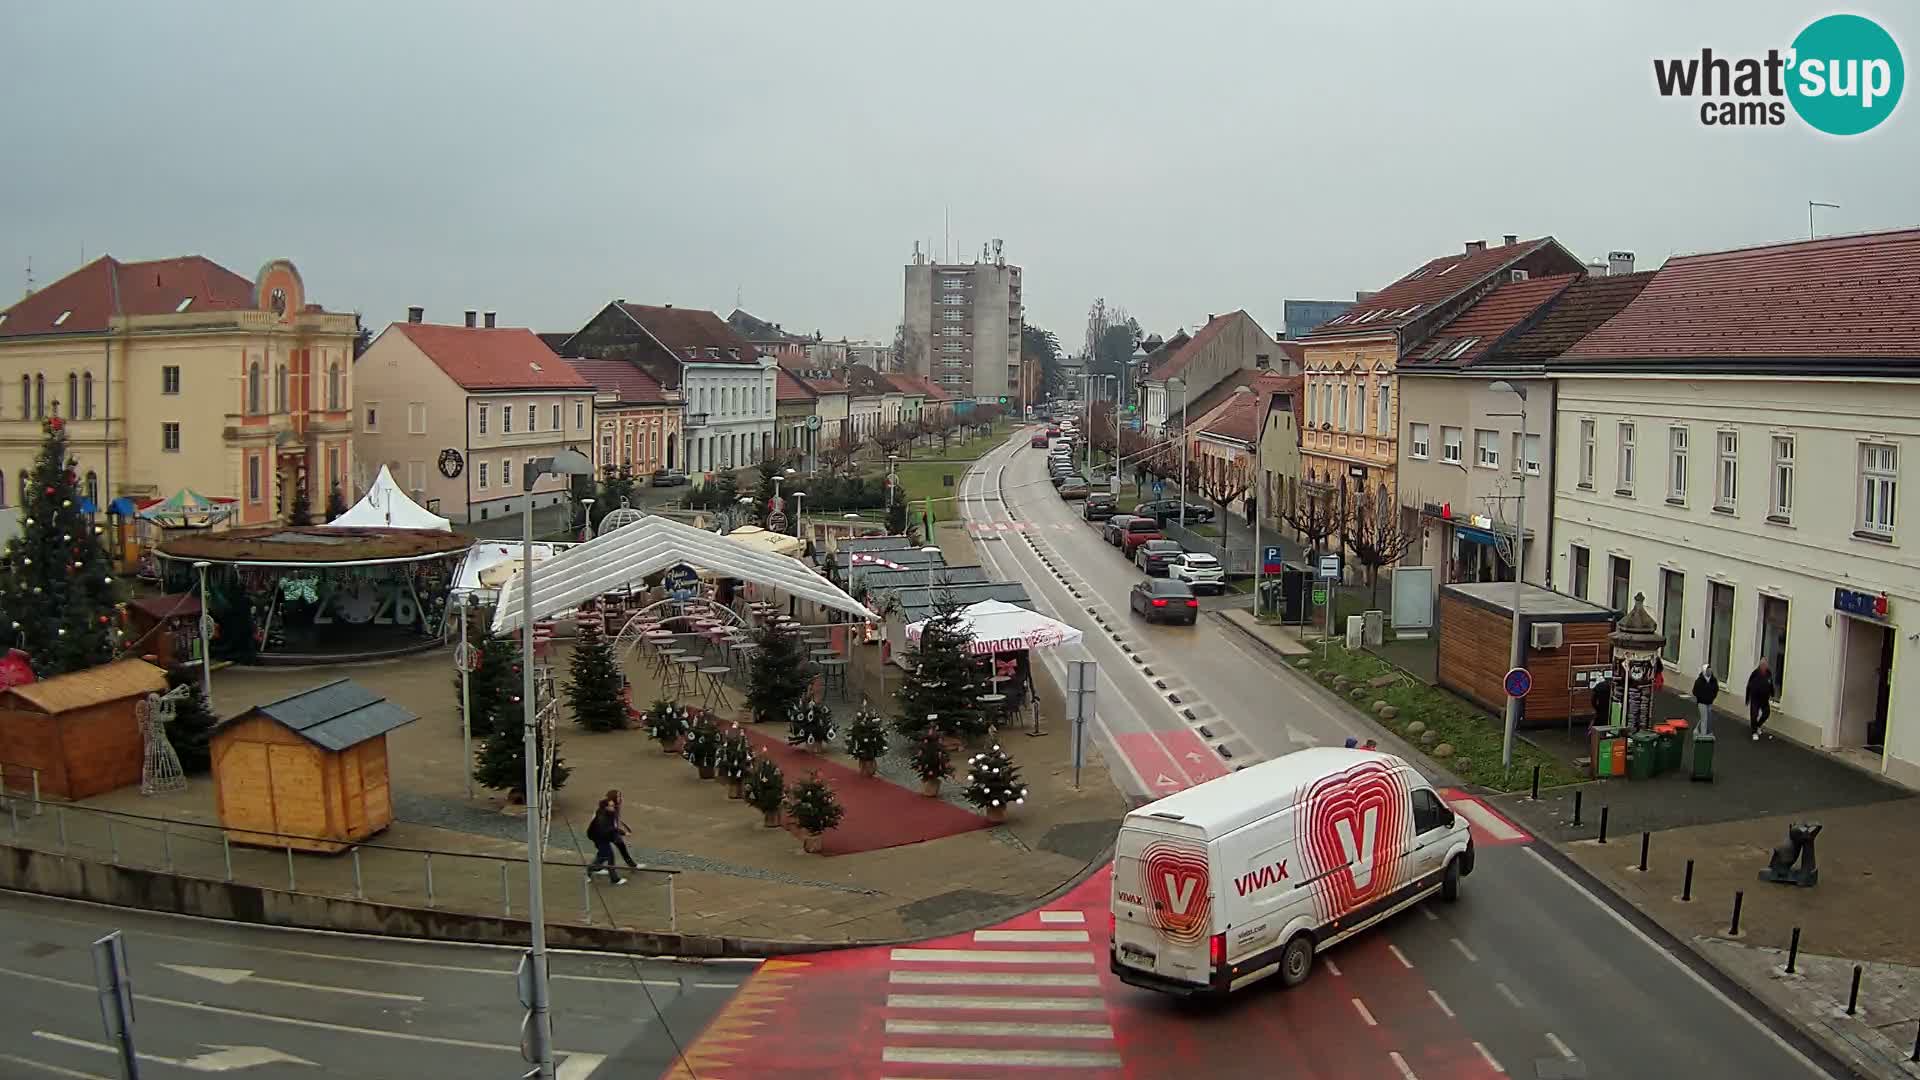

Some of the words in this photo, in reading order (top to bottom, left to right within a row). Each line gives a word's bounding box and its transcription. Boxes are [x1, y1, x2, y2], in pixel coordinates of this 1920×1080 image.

[1335, 806, 1377, 890] V
[1118, 891, 1142, 905] VIVAX
[1164, 872, 1197, 914] V
[1234, 859, 1288, 897] VIVAX
